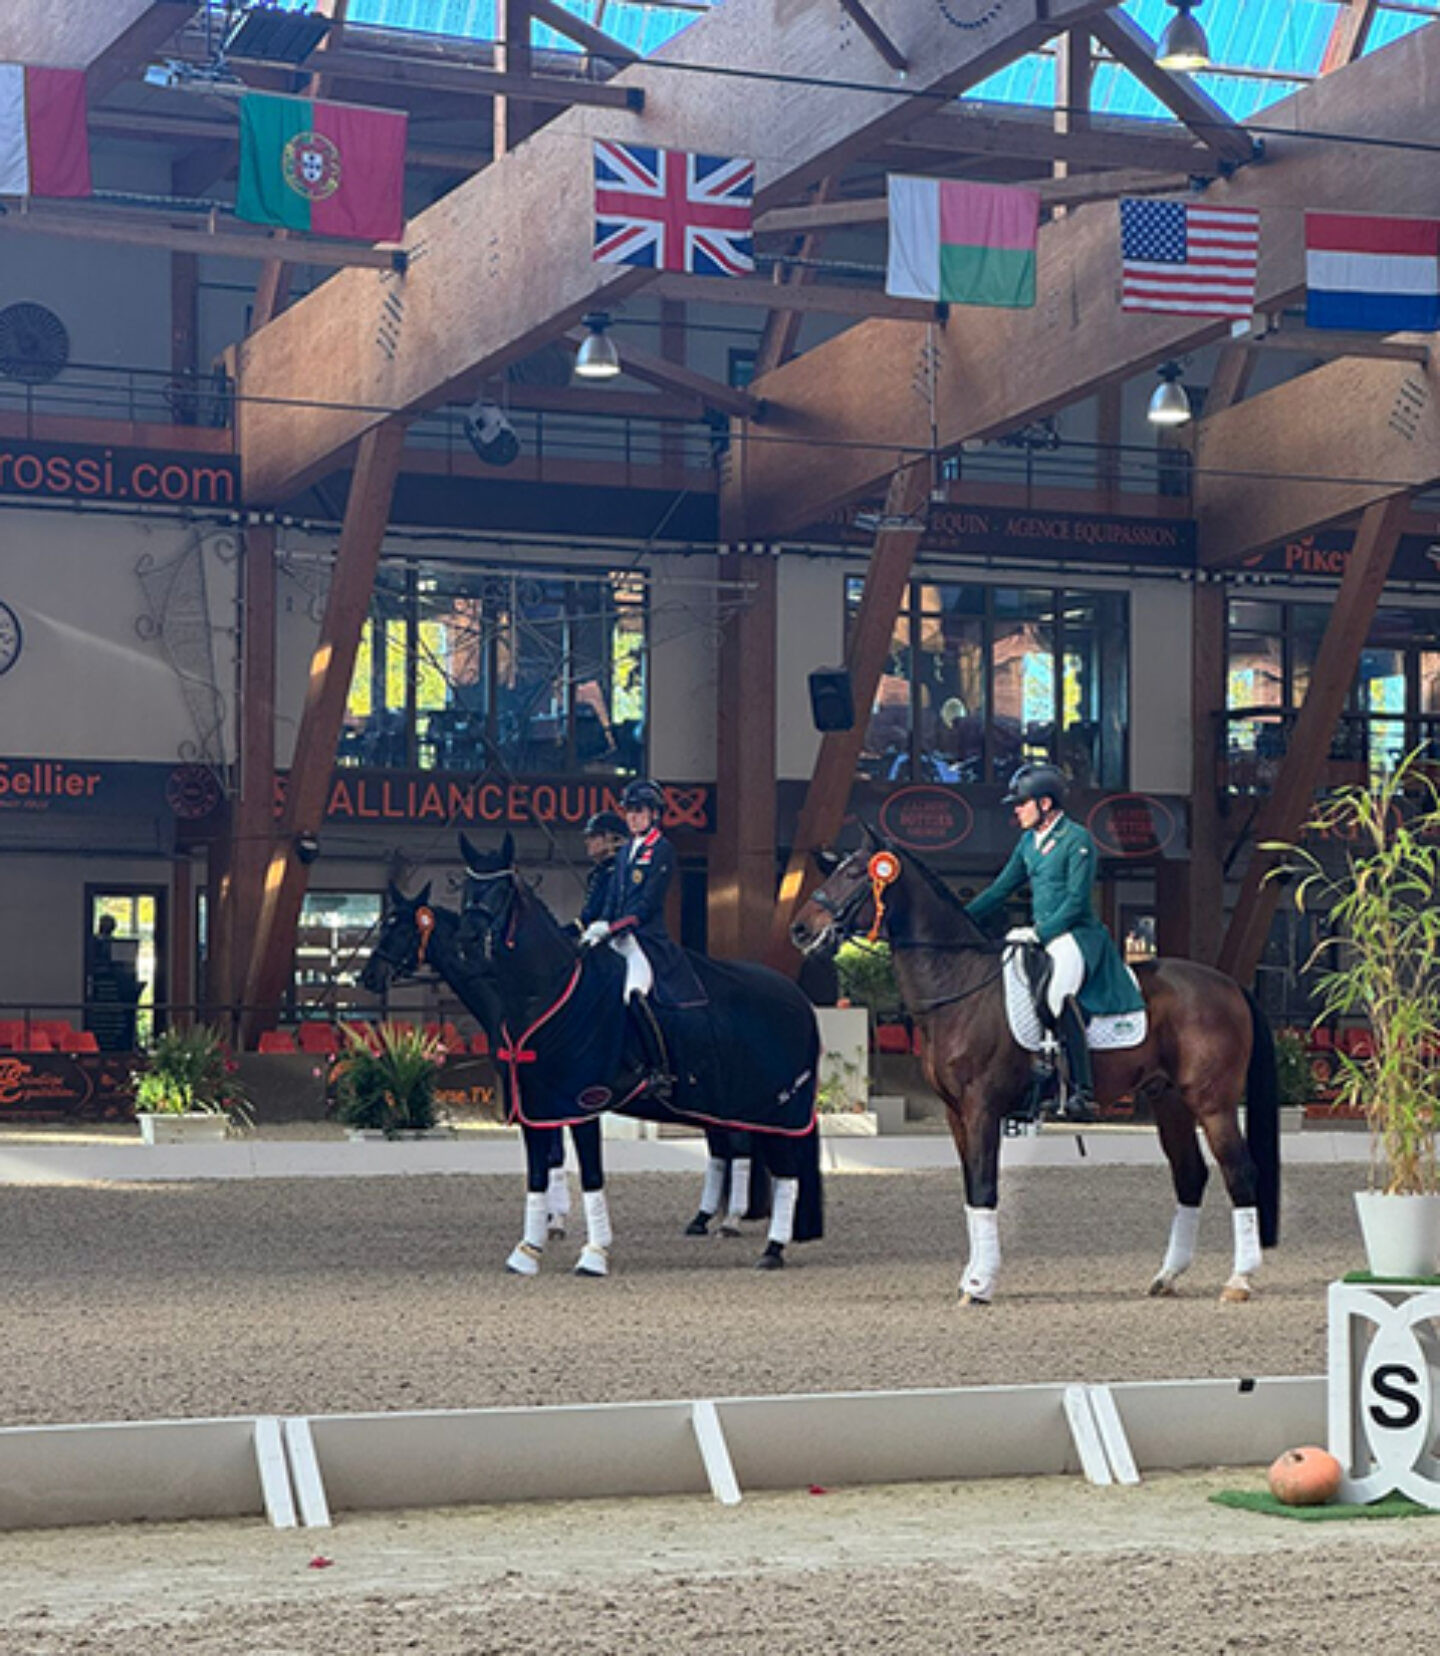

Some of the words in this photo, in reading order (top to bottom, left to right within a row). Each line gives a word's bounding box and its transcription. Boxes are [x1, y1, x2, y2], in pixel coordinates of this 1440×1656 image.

[0, 450, 233, 502] rossi.com
[1004, 517, 1071, 540] AGENCE
[1368, 1363, 1422, 1430] S
